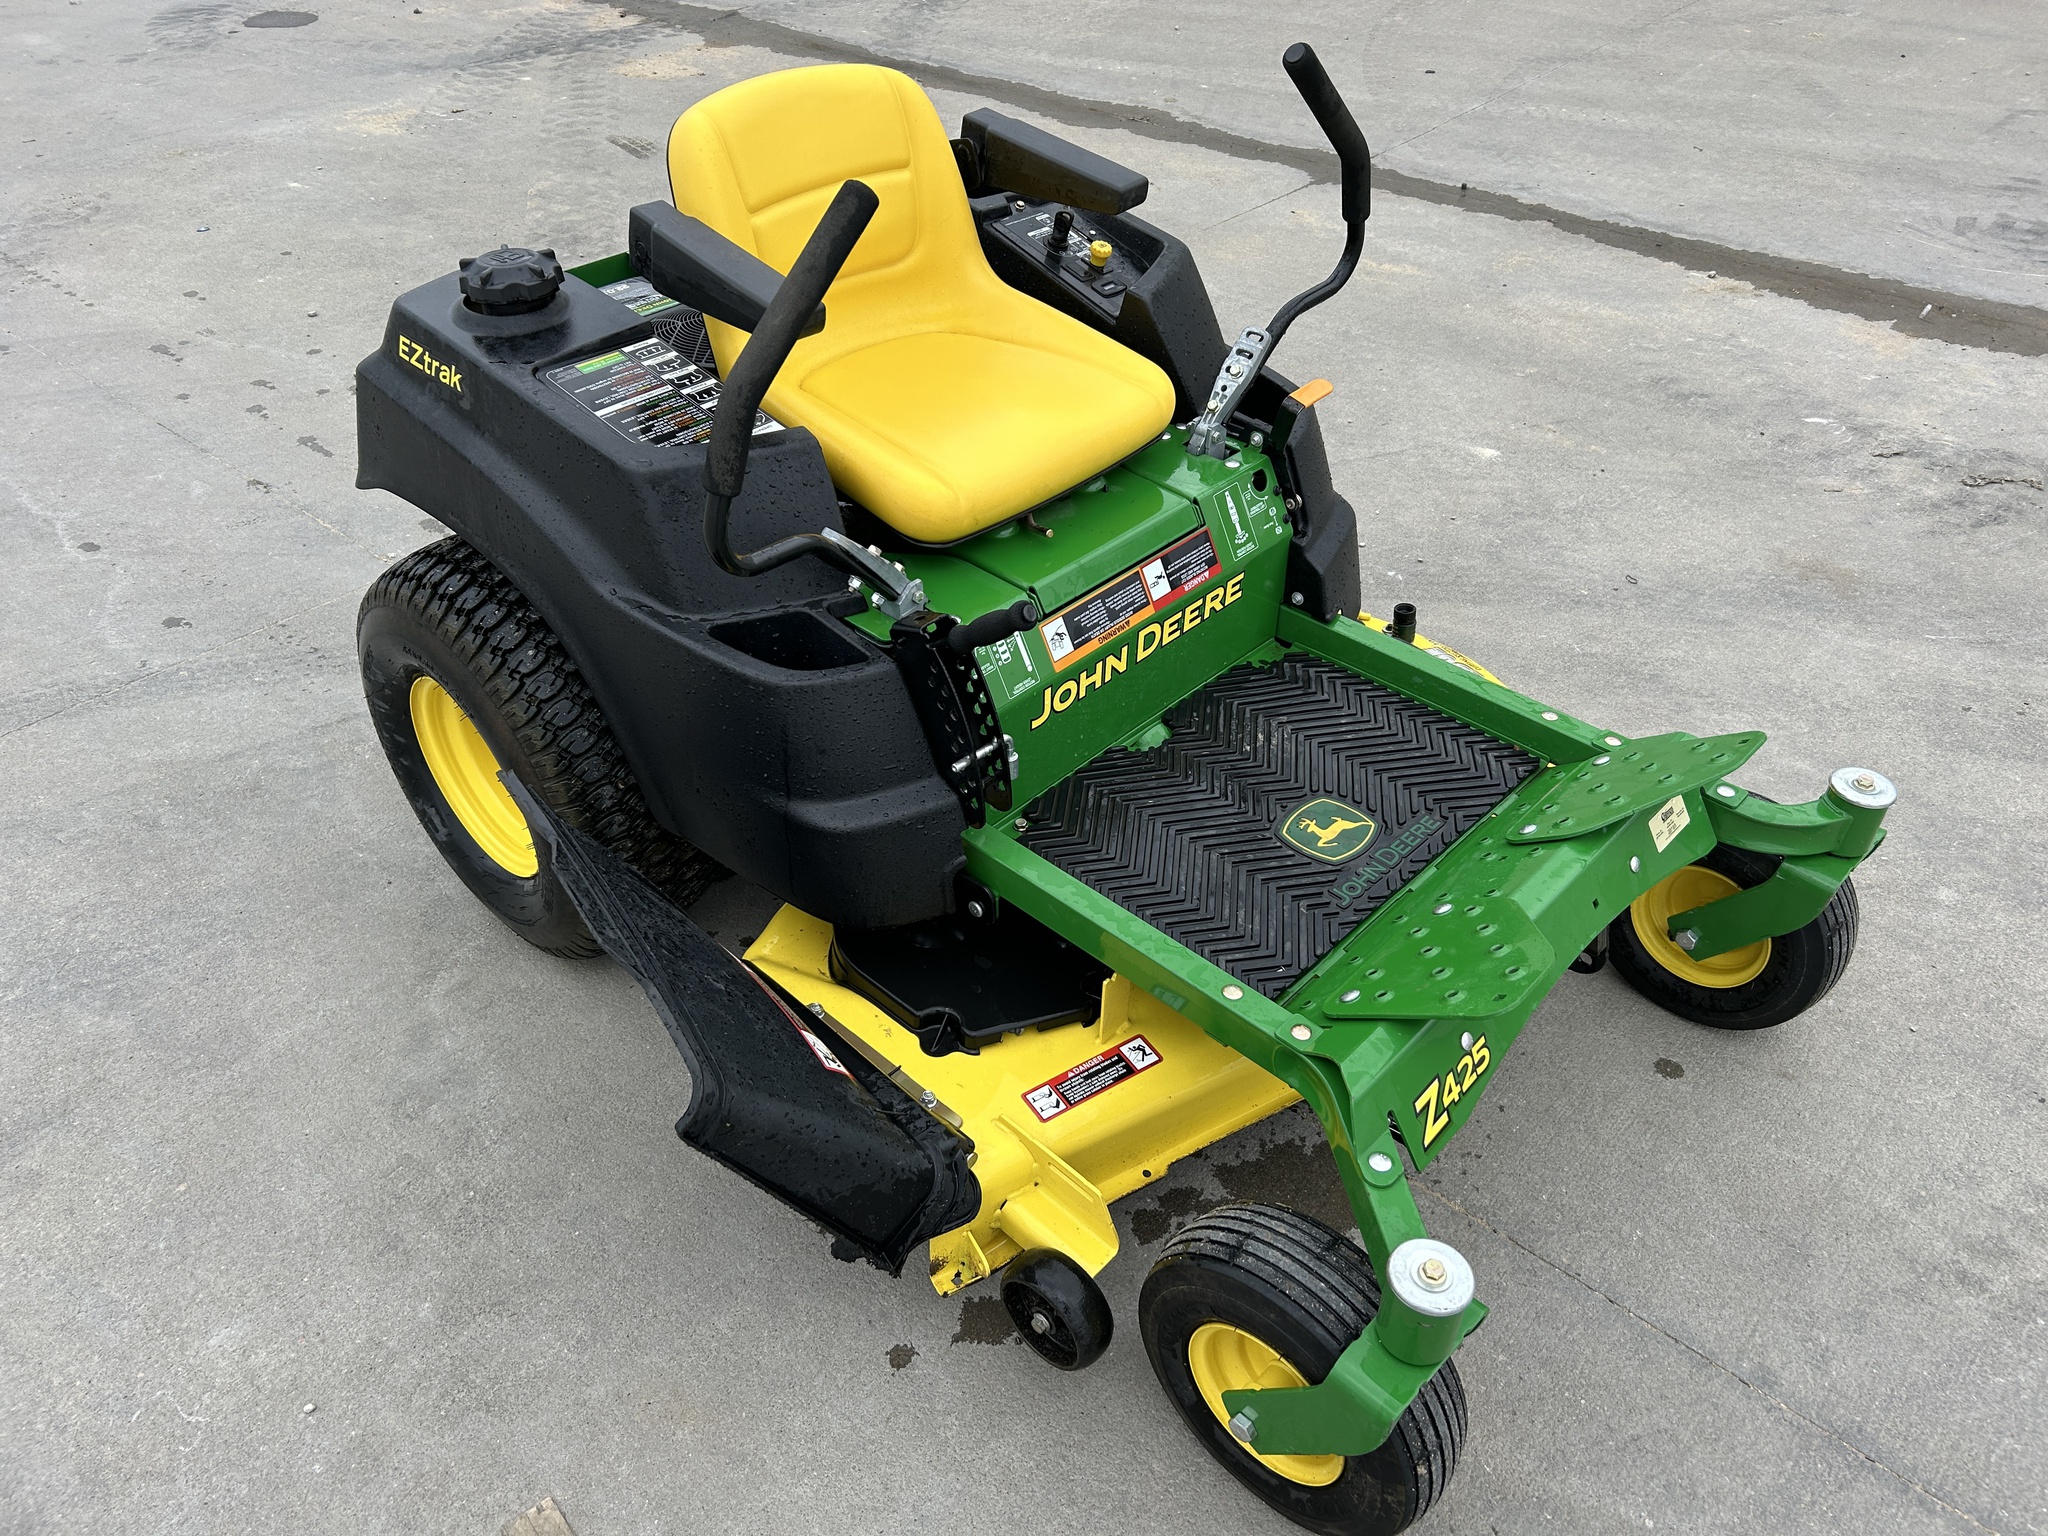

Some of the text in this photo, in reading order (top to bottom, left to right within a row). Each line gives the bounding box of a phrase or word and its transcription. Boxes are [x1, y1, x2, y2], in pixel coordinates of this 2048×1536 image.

[399, 334, 462, 392] EZtrak
[1183, 573, 1205, 592] DANGER
[1030, 645, 1129, 731] JOHN
[1136, 572, 1245, 663] DEERE
[1097, 622, 1126, 644] WARNING
[1332, 815, 1441, 907] JOHN DEERE
[1072, 1055, 1105, 1073] DANGER
[1413, 1034, 1491, 1150] Z425
